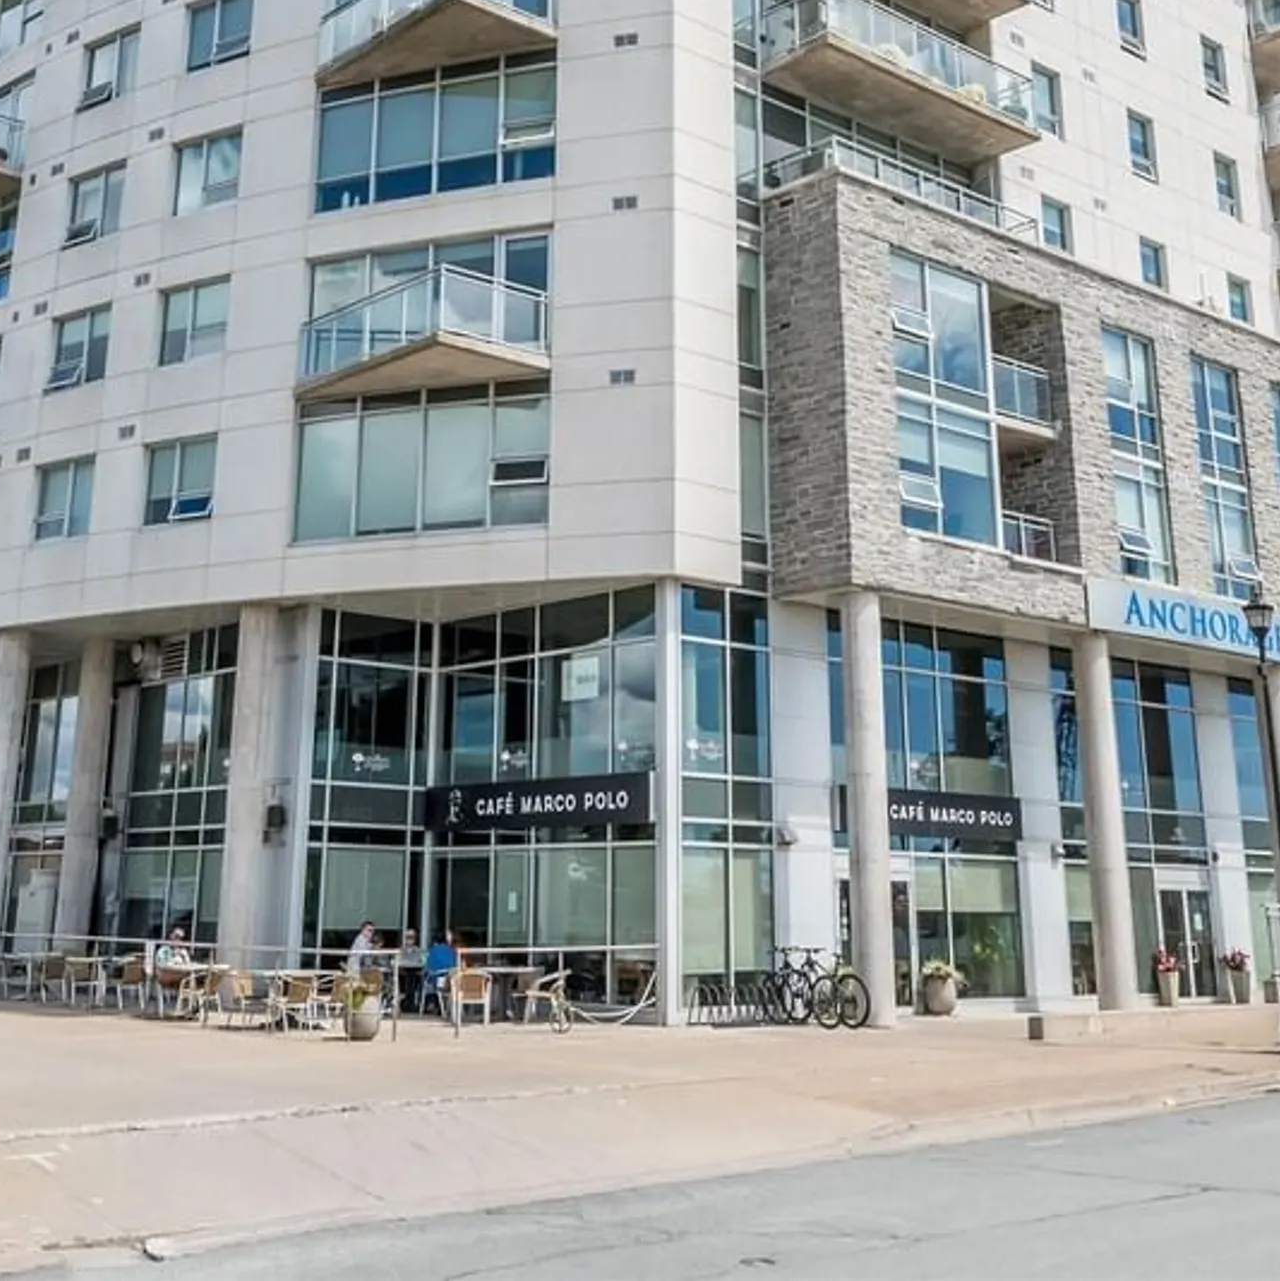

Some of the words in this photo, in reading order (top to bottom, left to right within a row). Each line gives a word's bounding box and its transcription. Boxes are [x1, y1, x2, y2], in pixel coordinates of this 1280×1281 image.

[476, 792, 513, 815] CAFÉ
[520, 794, 577, 813] MARCO
[584, 791, 629, 810] POLO
[889, 801, 924, 821] CAFÉ
[930, 806, 975, 824] MARCO
[980, 810, 1014, 827] POLO
